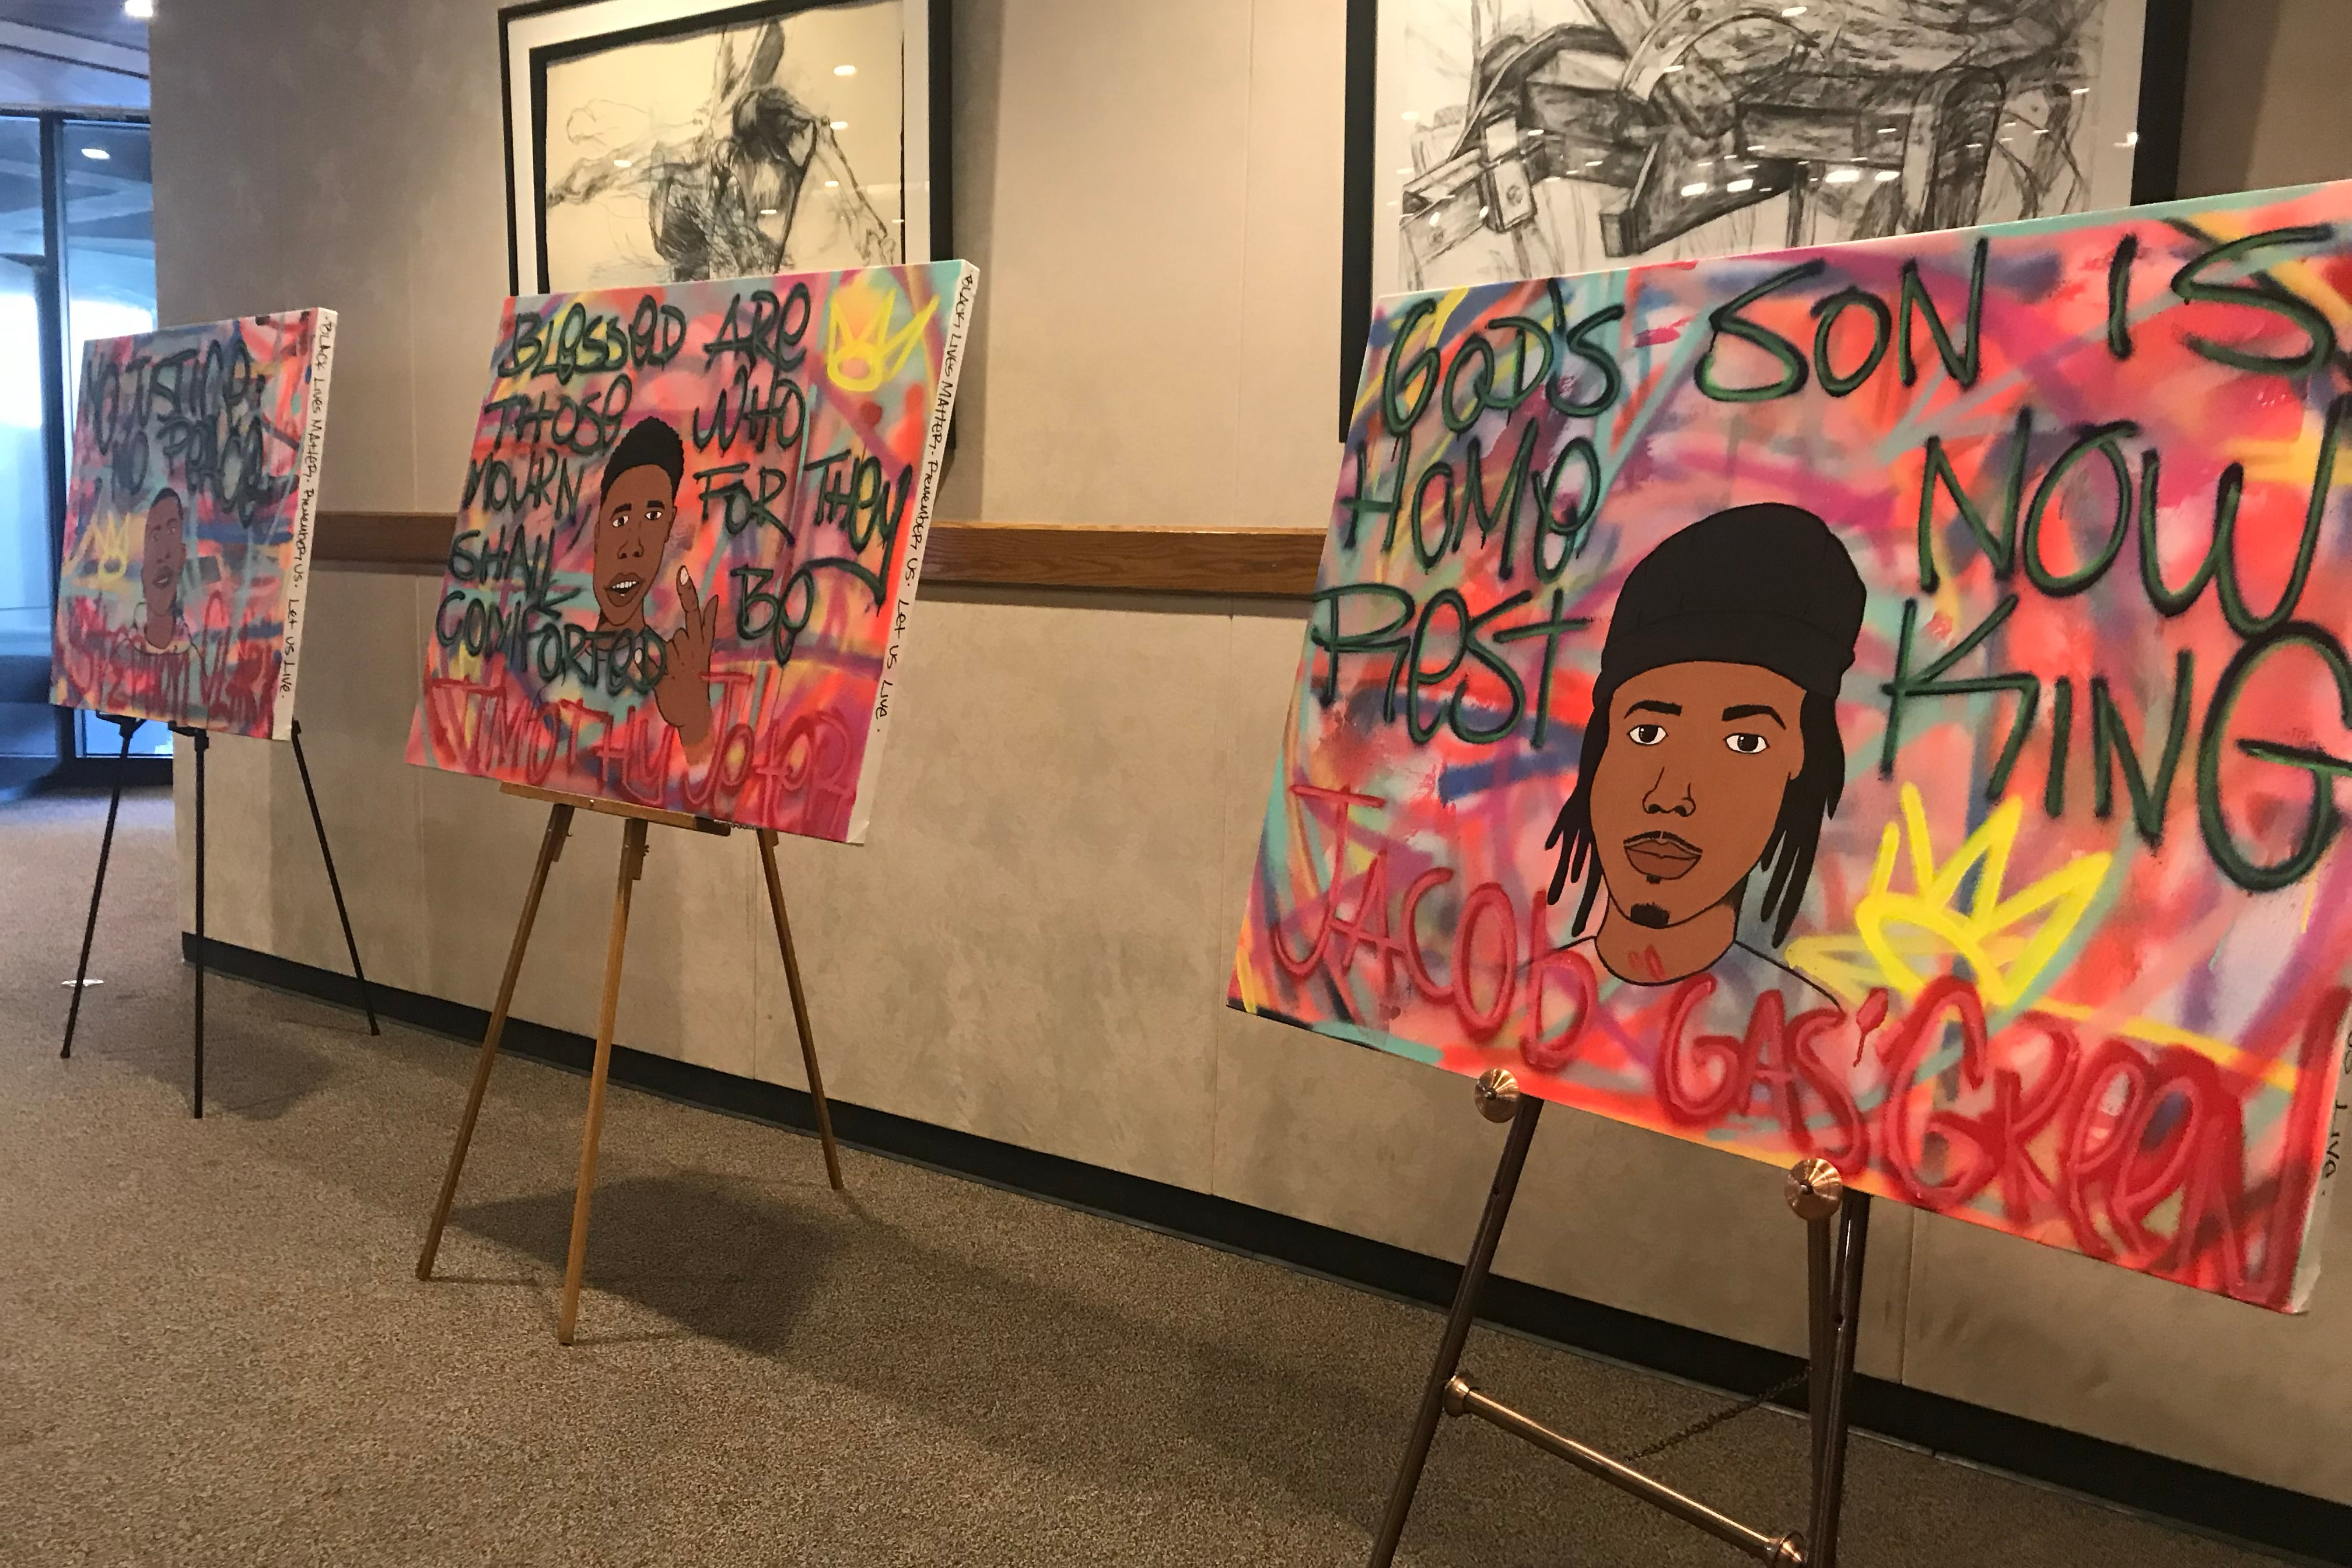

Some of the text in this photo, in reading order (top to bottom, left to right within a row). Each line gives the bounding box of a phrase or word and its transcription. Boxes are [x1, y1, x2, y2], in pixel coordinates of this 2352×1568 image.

[498, 282, 811, 386] BLESSED ARE
[953, 274, 973, 328] BLACK
[1383, 223, 2337, 439] GOD'S SON IS
[944, 333, 962, 377] LIVES
[484, 365, 806, 457] THOSE WHO
[692, 463, 796, 547] FOR
[803, 449, 913, 610] THEY
[1340, 392, 2352, 639] HOME NOW
[284, 636, 295, 654] US
[436, 590, 667, 697] COMFORTED
[447, 524, 814, 667] SHALL BE
[894, 598, 909, 639] LET
[887, 645, 898, 670] US
[425, 674, 677, 809] TIMOTHY
[1311, 583, 2352, 892] REST KING
[1270, 785, 1598, 1072] JACOB
[1875, 974, 2350, 1312] GREEN
